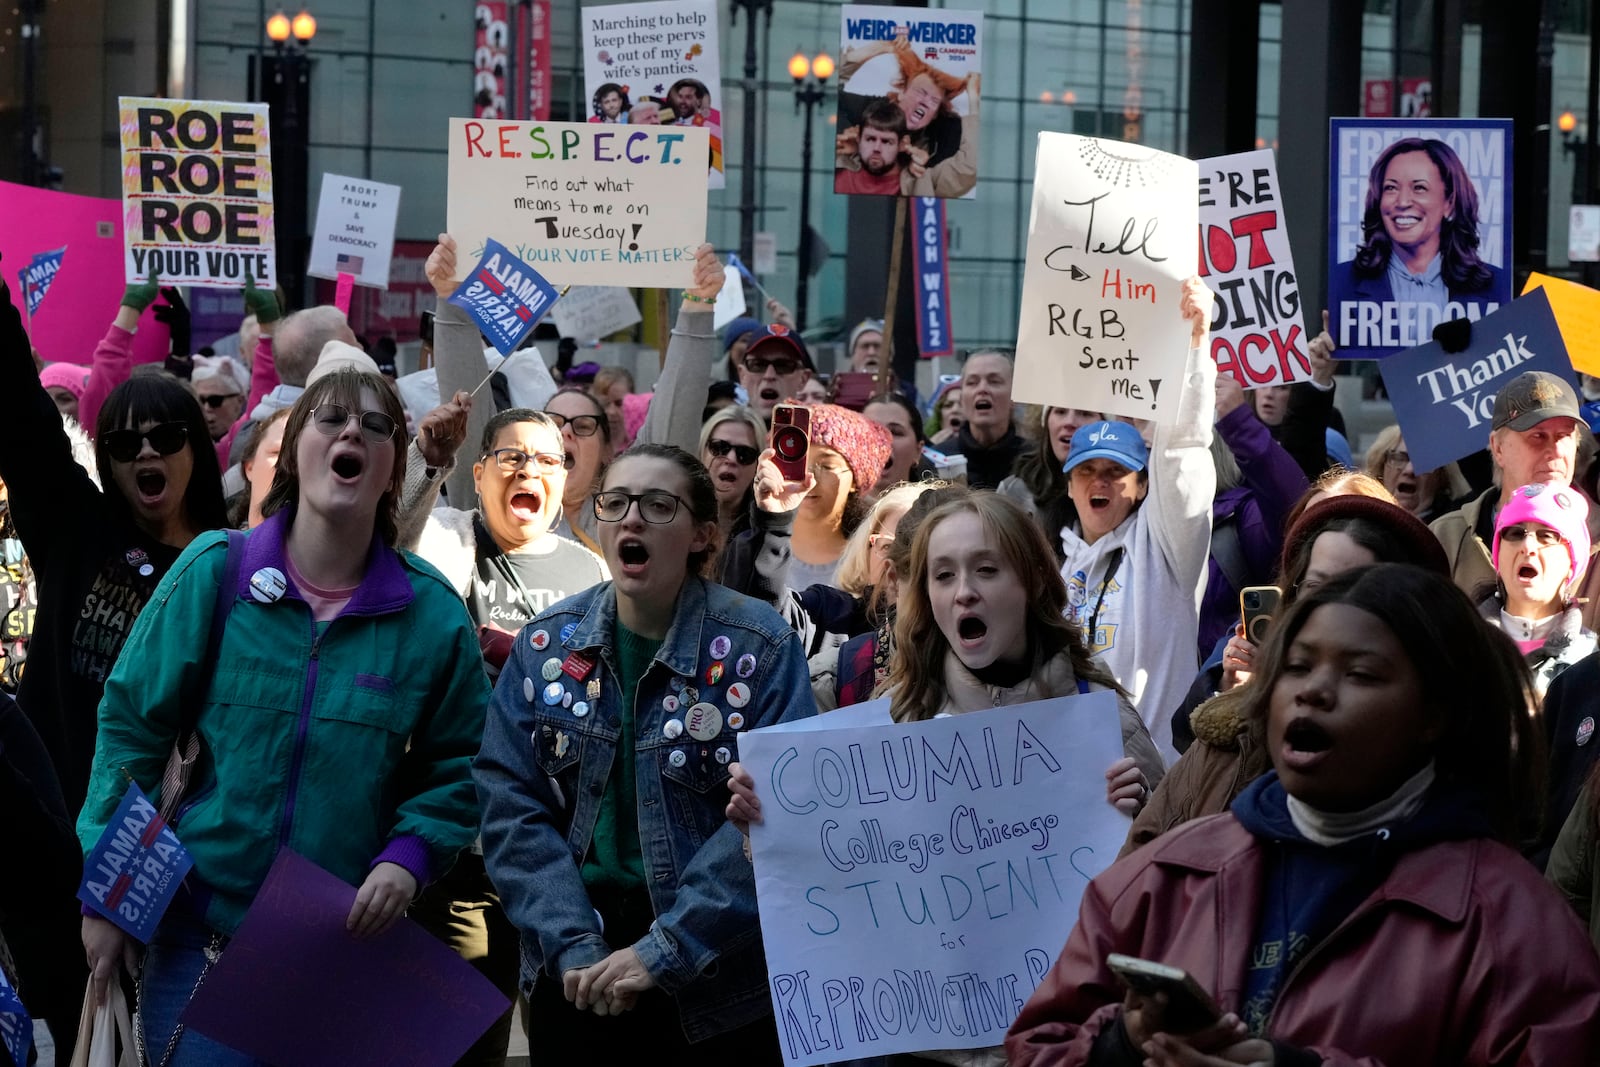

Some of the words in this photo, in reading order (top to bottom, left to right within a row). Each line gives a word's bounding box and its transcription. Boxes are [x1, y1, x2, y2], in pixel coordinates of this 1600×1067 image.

[592, 16, 656, 31] Marching
[660, 14, 673, 26] to
[676, 11, 706, 26] help
[847, 18, 897, 41] WEIRD
[594, 35, 625, 48] keep
[628, 32, 663, 44] these
[667, 30, 705, 44] pervs
[617, 51, 640, 62] out
[642, 47, 658, 59] of
[661, 48, 682, 60] my
[604, 65, 640, 79] wife's
[644, 62, 698, 79] panties.
[136, 107, 257, 153] ROE
[139, 153, 259, 199] ROE
[525, 176, 558, 192] Find
[566, 176, 588, 192] out
[594, 176, 635, 192] what
[1198, 168, 1274, 208] E'RE
[340, 196, 378, 209] TRUMP
[343, 184, 379, 197] ABORT
[354, 212, 360, 220] &
[514, 197, 561, 211] means
[568, 198, 588, 214] to
[593, 204, 614, 216] me
[626, 204, 649, 216] on
[141, 200, 261, 246] ROE
[345, 224, 365, 234] SAVE
[1064, 192, 1168, 262] Tell
[328, 234, 378, 249] DEMOCRACY
[131, 247, 200, 278] YOUR
[206, 250, 269, 280] VOTE
[516, 244, 561, 263] YOUR
[565, 248, 614, 264] VOTE
[618, 247, 697, 264] MATTERS
[1102, 268, 1156, 304] Him
[922, 273, 942, 347] WALZ
[1078, 347, 1140, 371] Sent
[1210, 324, 1313, 389] ACK
[1416, 332, 1536, 405] Thank
[1450, 390, 1497, 430] Yo
[690, 708, 704, 732] PRO
[771, 719, 1062, 815] COLUMIA
[820, 819, 945, 874] College
[949, 804, 1059, 854] Chicago
[806, 846, 1096, 936] STUDENTS
[940, 932, 966, 951] for
[772, 968, 1024, 1061] REPRODUCTIVE
